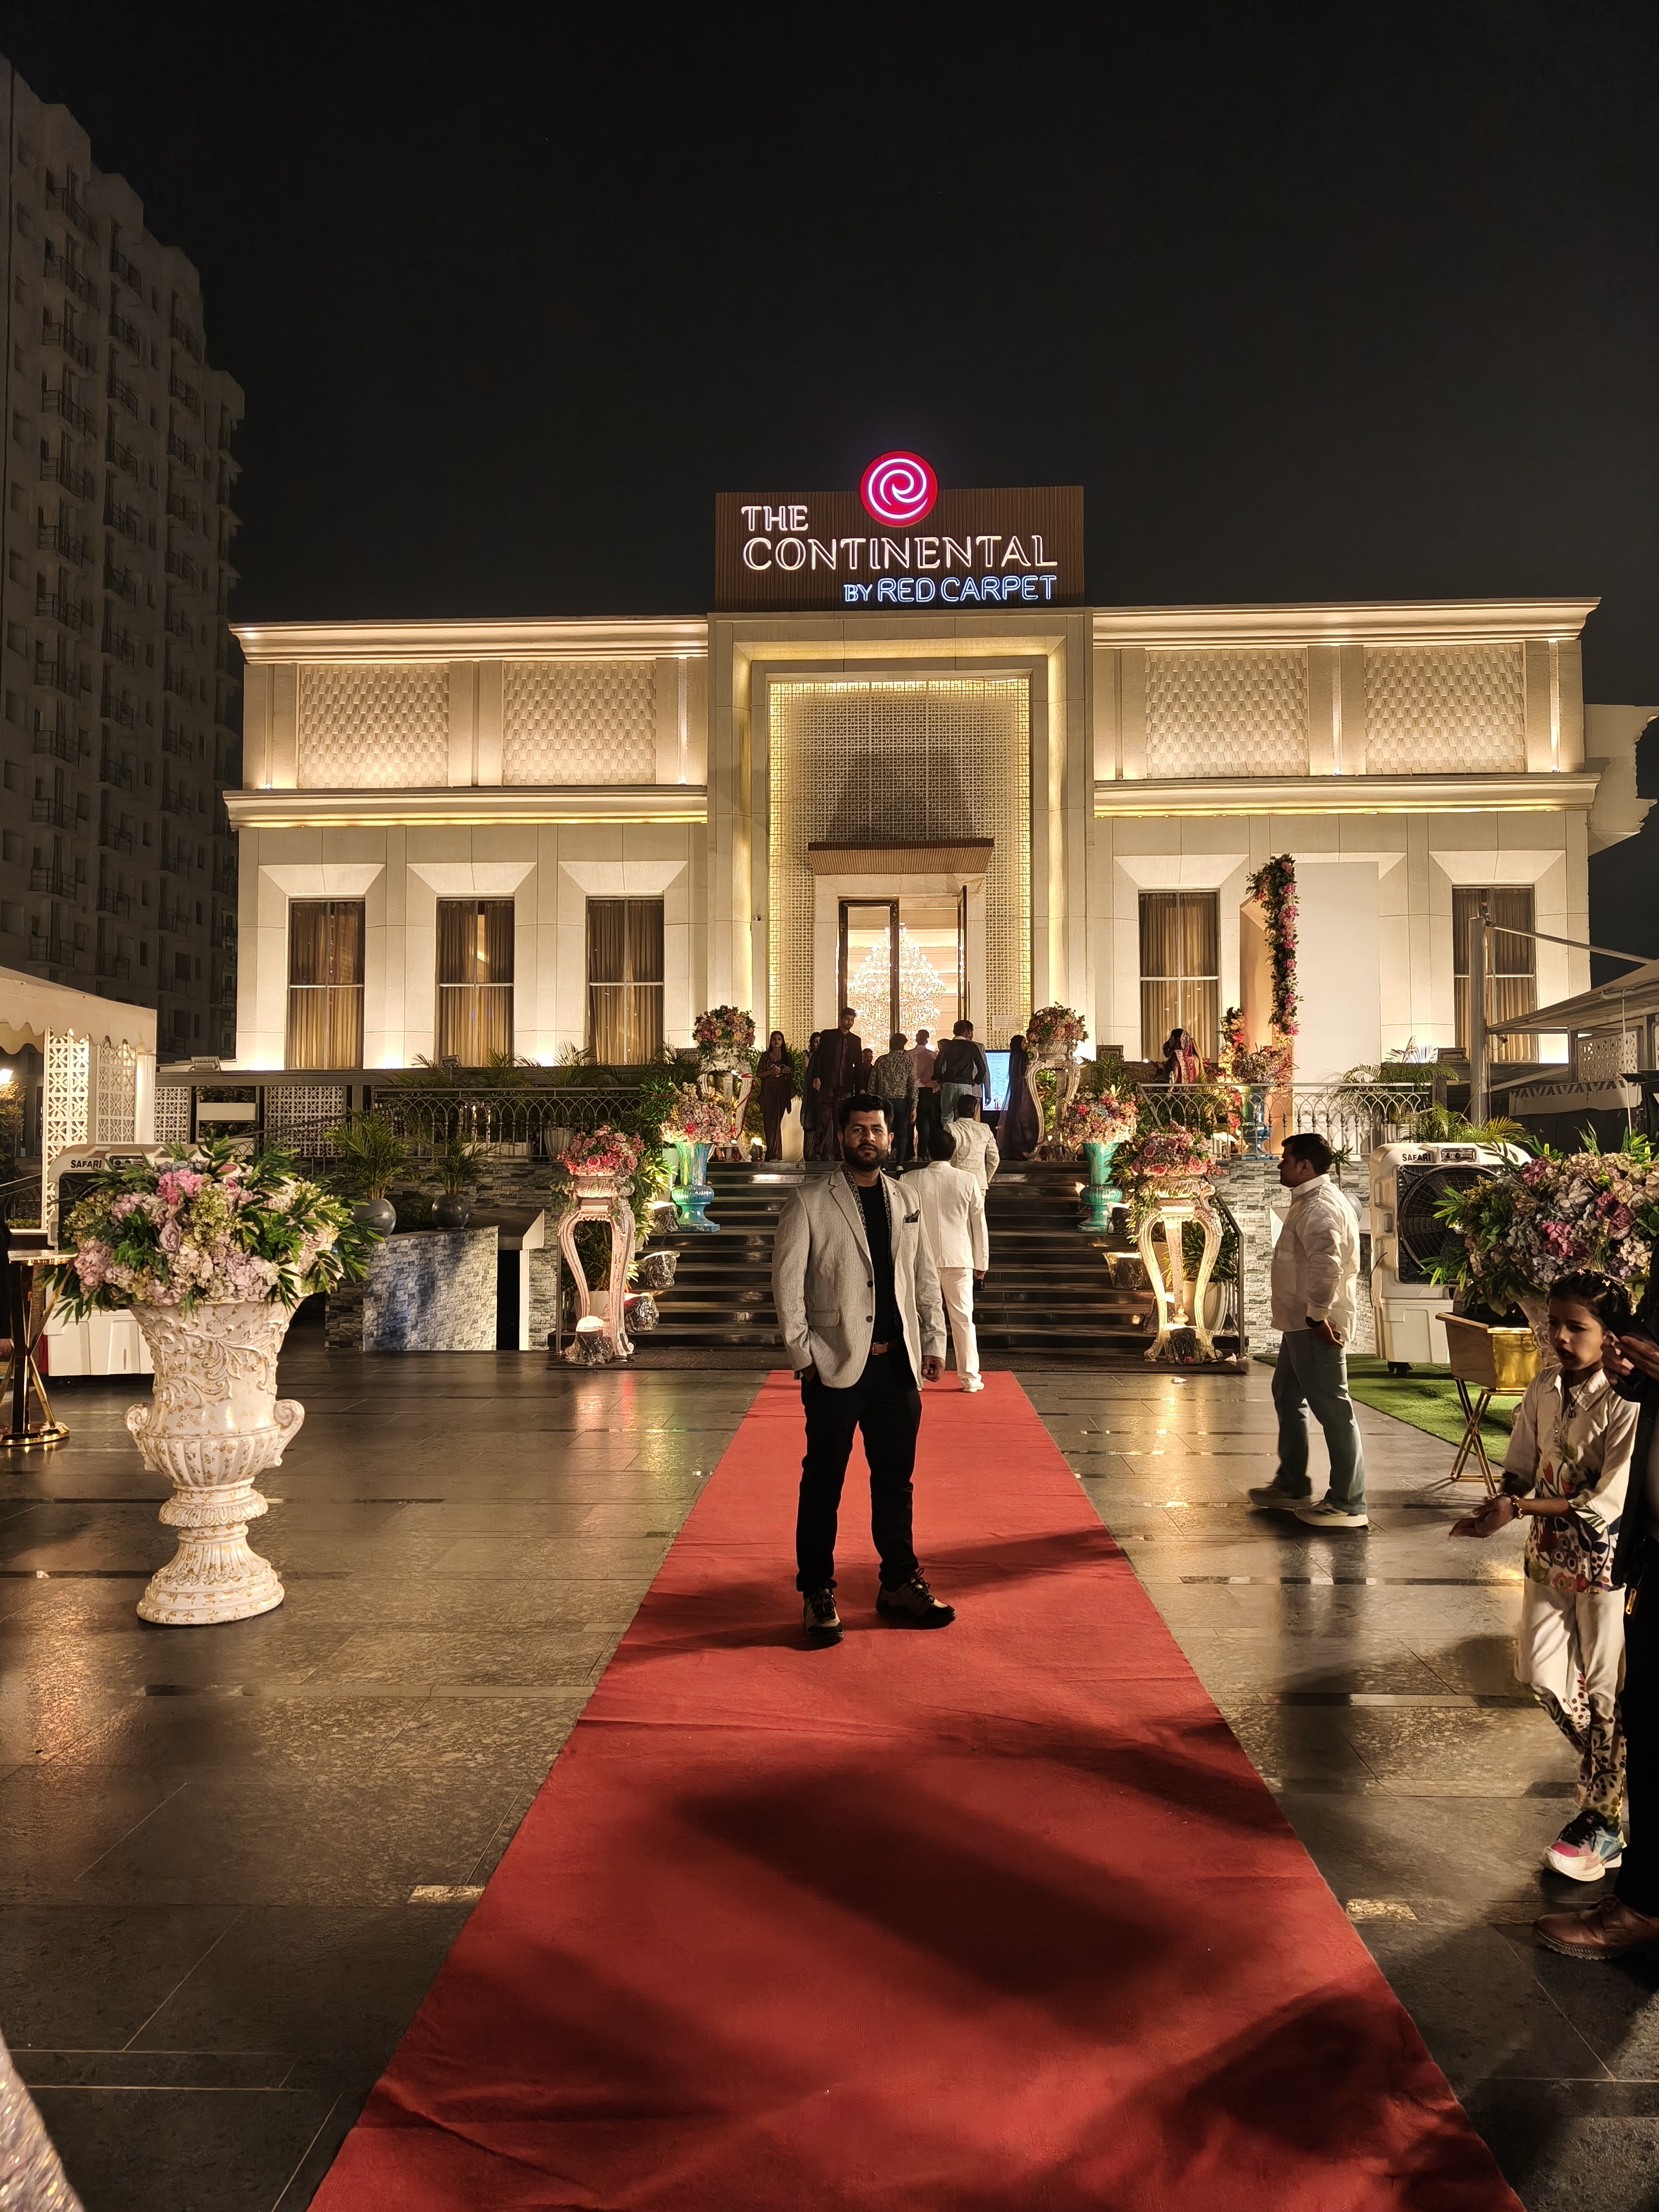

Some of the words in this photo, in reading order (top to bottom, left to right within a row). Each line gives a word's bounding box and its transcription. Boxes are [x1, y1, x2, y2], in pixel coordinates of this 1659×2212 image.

[741, 505, 809, 532] THE
[743, 535, 1058, 571] CONTINENTAL
[843, 584, 873, 602] BY
[877, 577, 936, 602] RED
[940, 575, 1057, 602] CARPET
[70, 1159, 102, 1169] SAFARI
[1402, 1153, 1431, 1162] SAFARI
